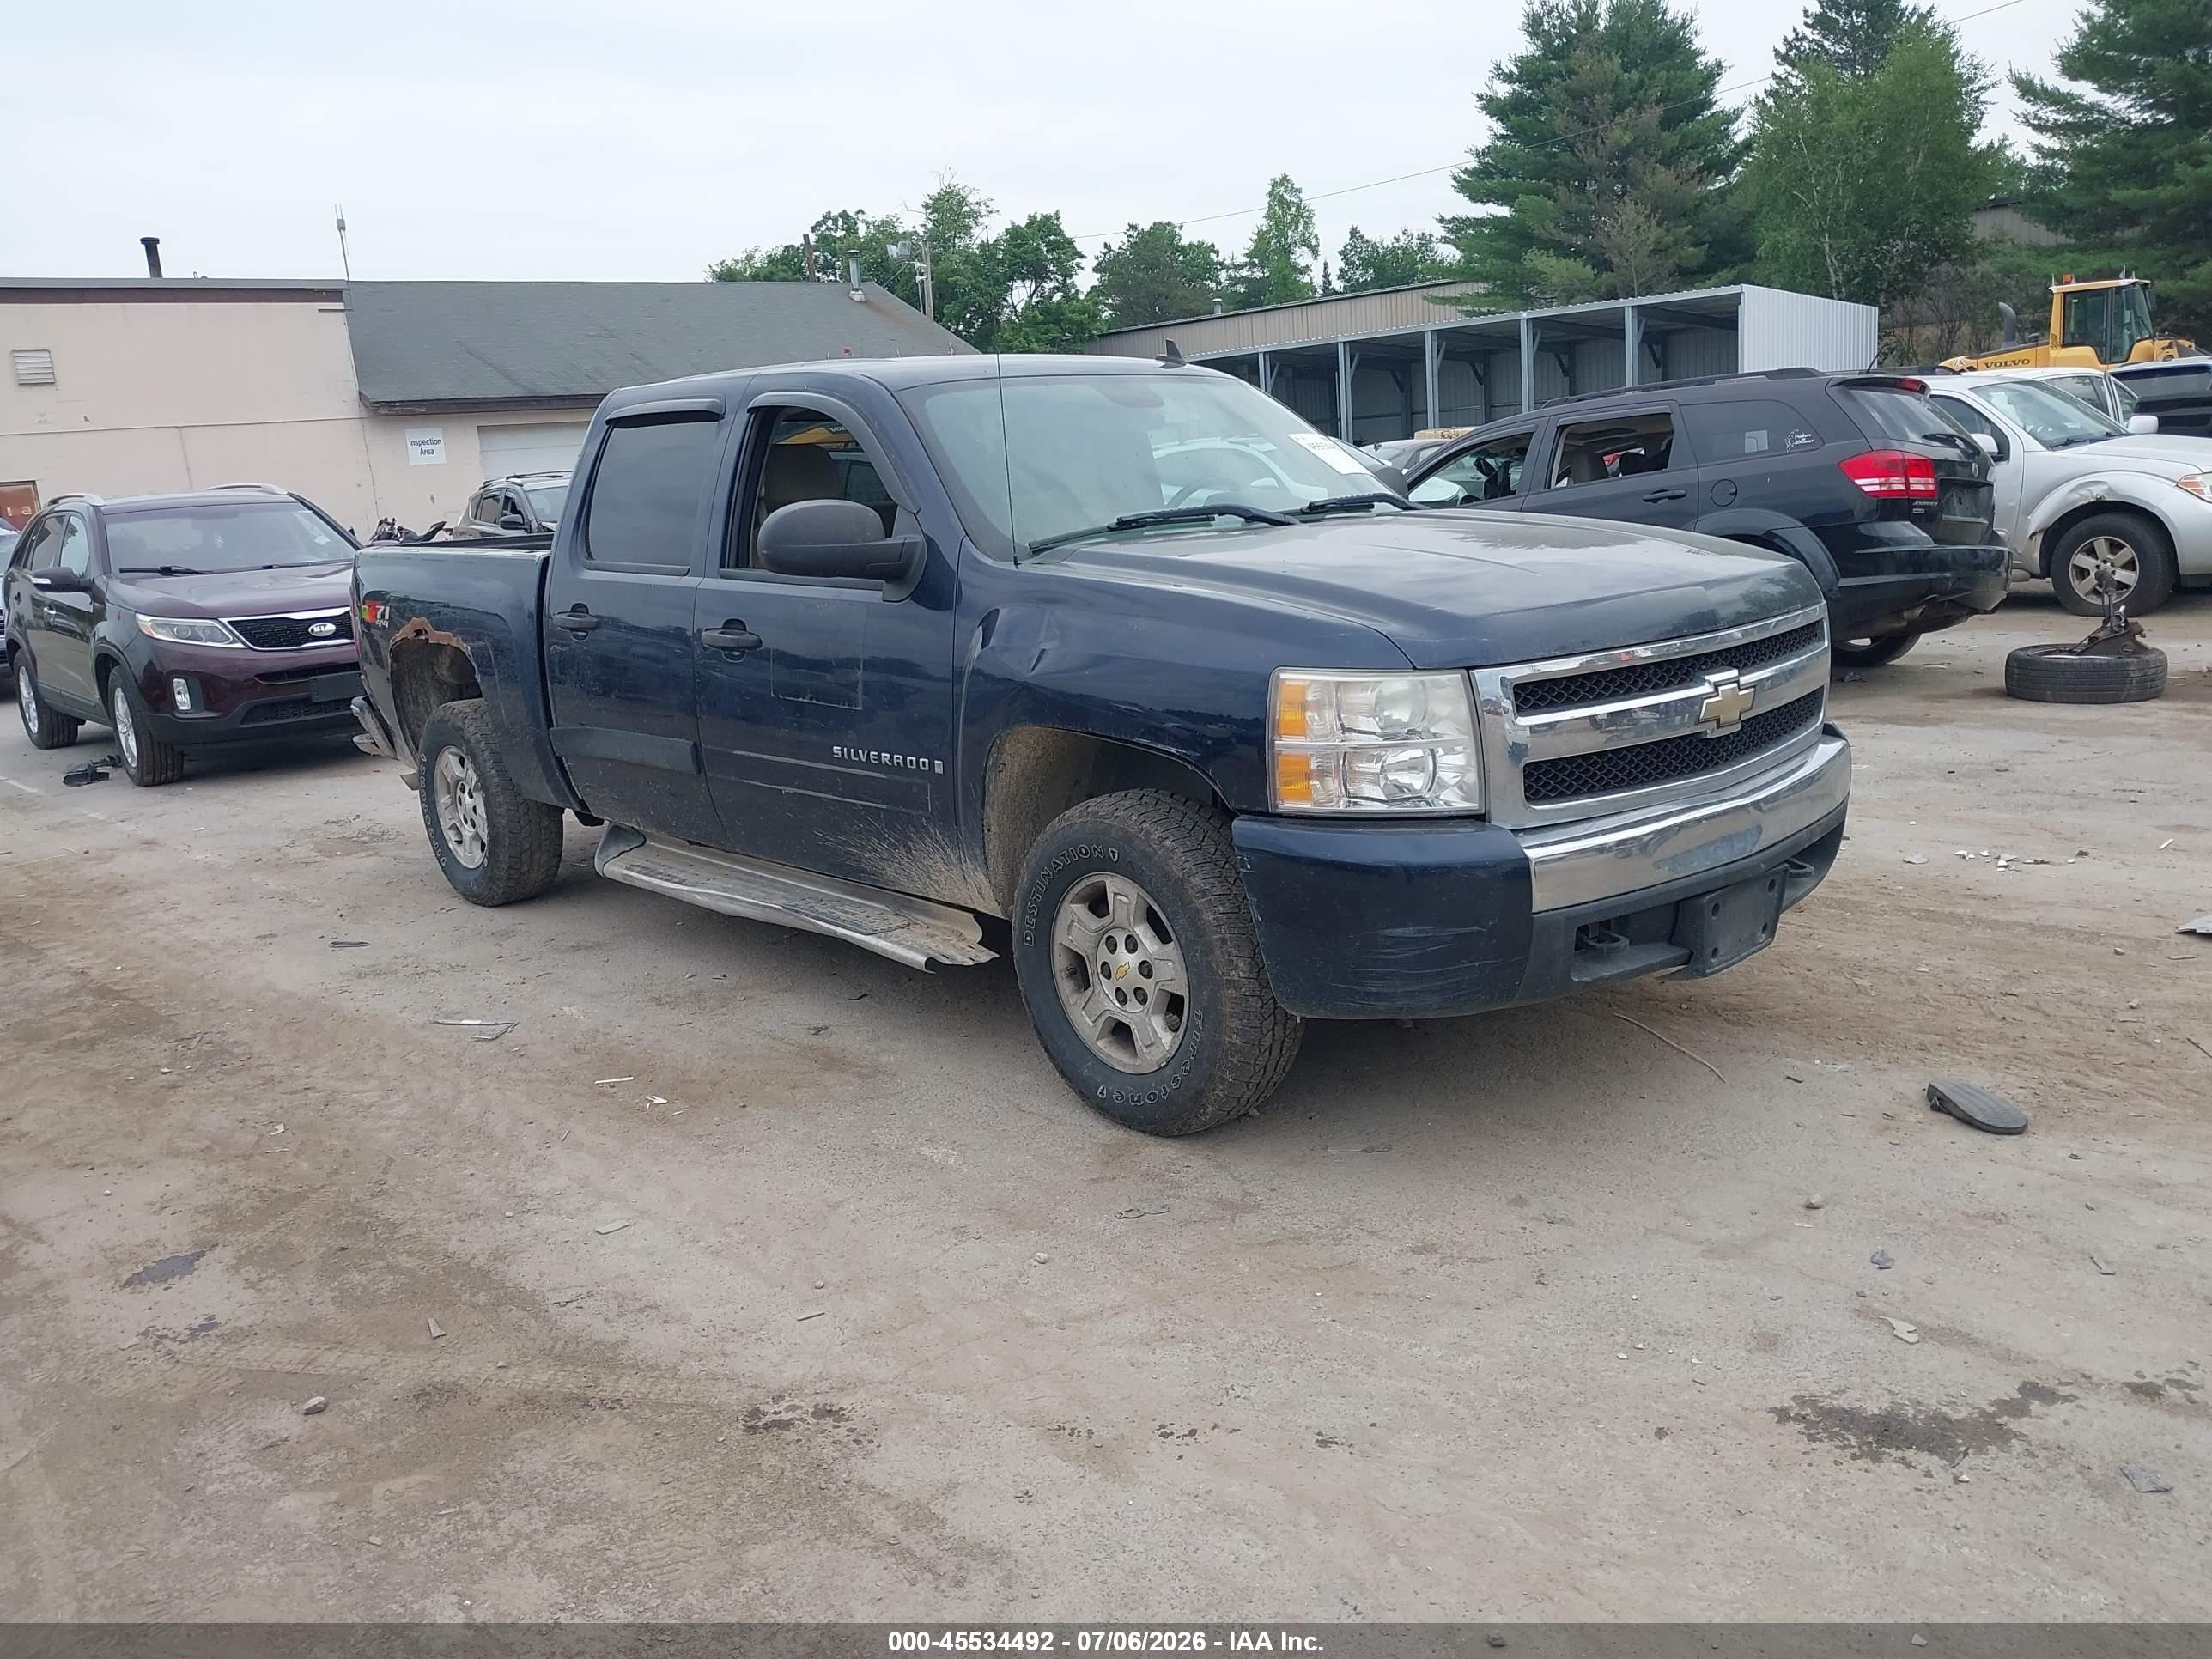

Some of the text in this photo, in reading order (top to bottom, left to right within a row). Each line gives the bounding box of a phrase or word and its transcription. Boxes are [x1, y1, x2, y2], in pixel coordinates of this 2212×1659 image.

[1984, 358, 2030, 368] VOLVO
[409, 437, 442, 447] Inspection
[832, 745, 930, 771] SILVERADO
[1023, 844, 1104, 946] DESTINATION
